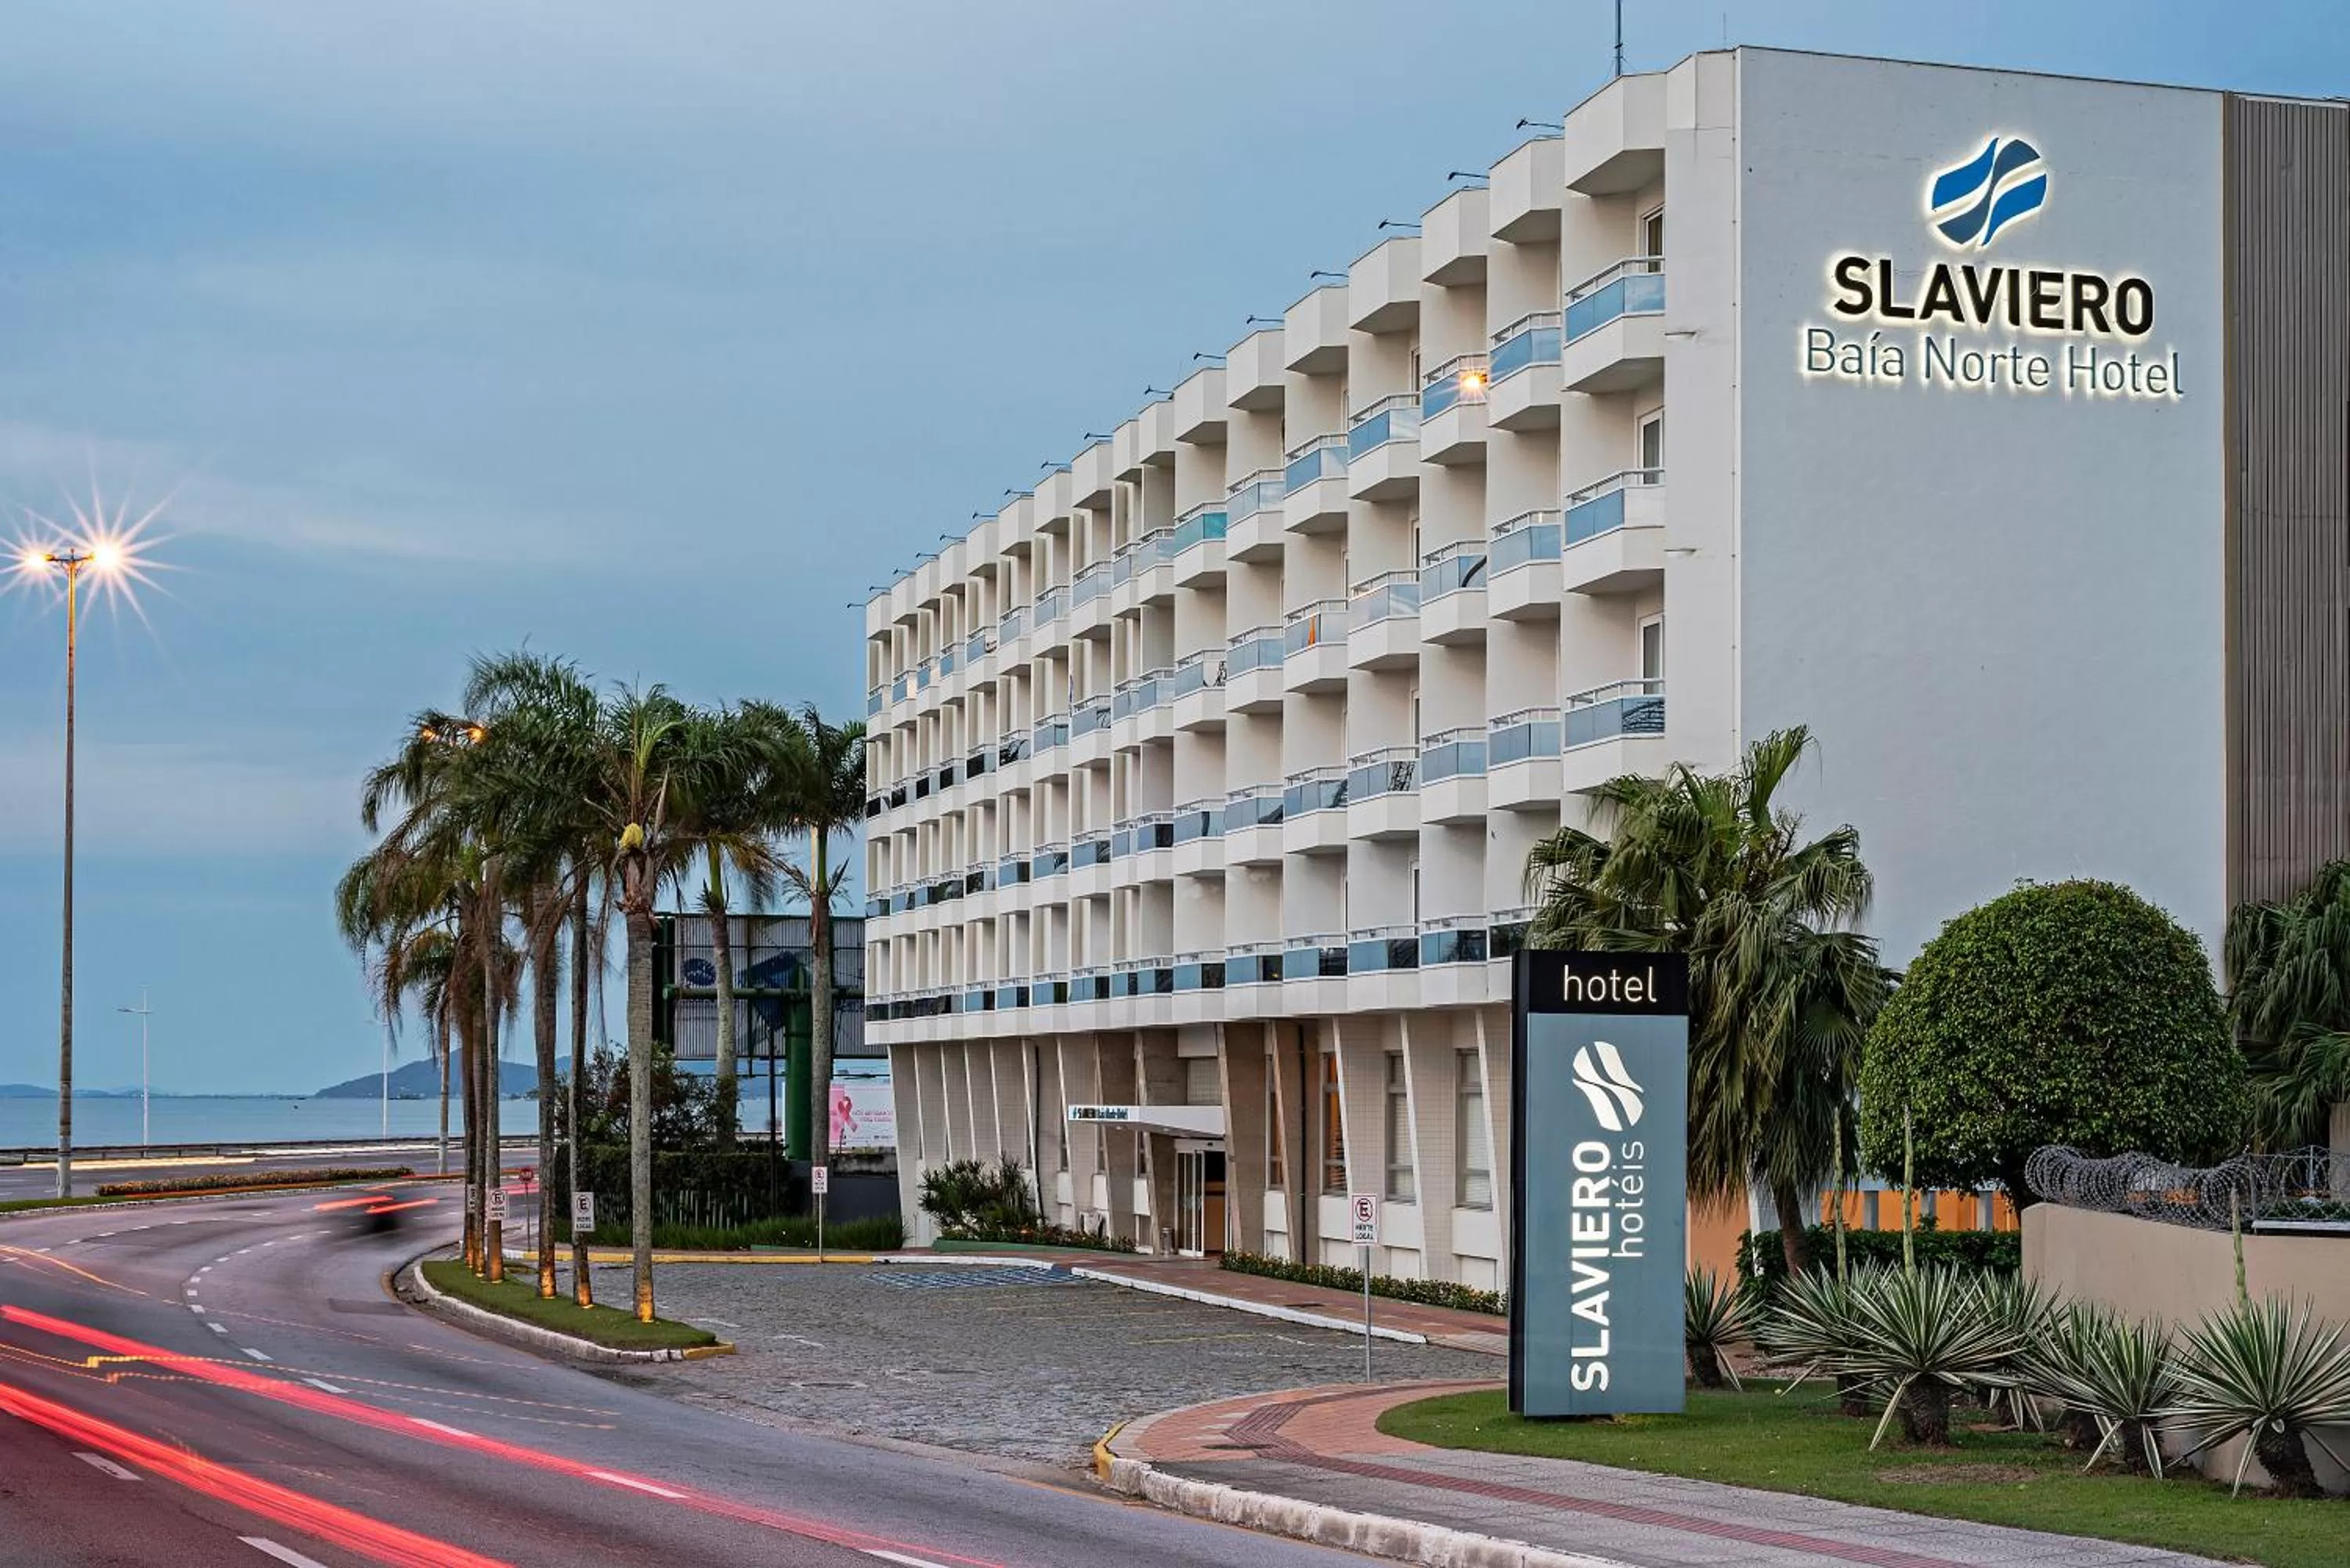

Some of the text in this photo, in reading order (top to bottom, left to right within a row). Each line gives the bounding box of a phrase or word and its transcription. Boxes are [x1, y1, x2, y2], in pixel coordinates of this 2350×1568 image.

[1833, 255, 2154, 336] SLAVIERO
[1806, 327, 2185, 395] Baía Norte Hotel
[1563, 965, 1658, 1003] hotel
[1611, 1140, 1644, 1258] hotéis
[1571, 1140, 1611, 1393] SLAVIERO
